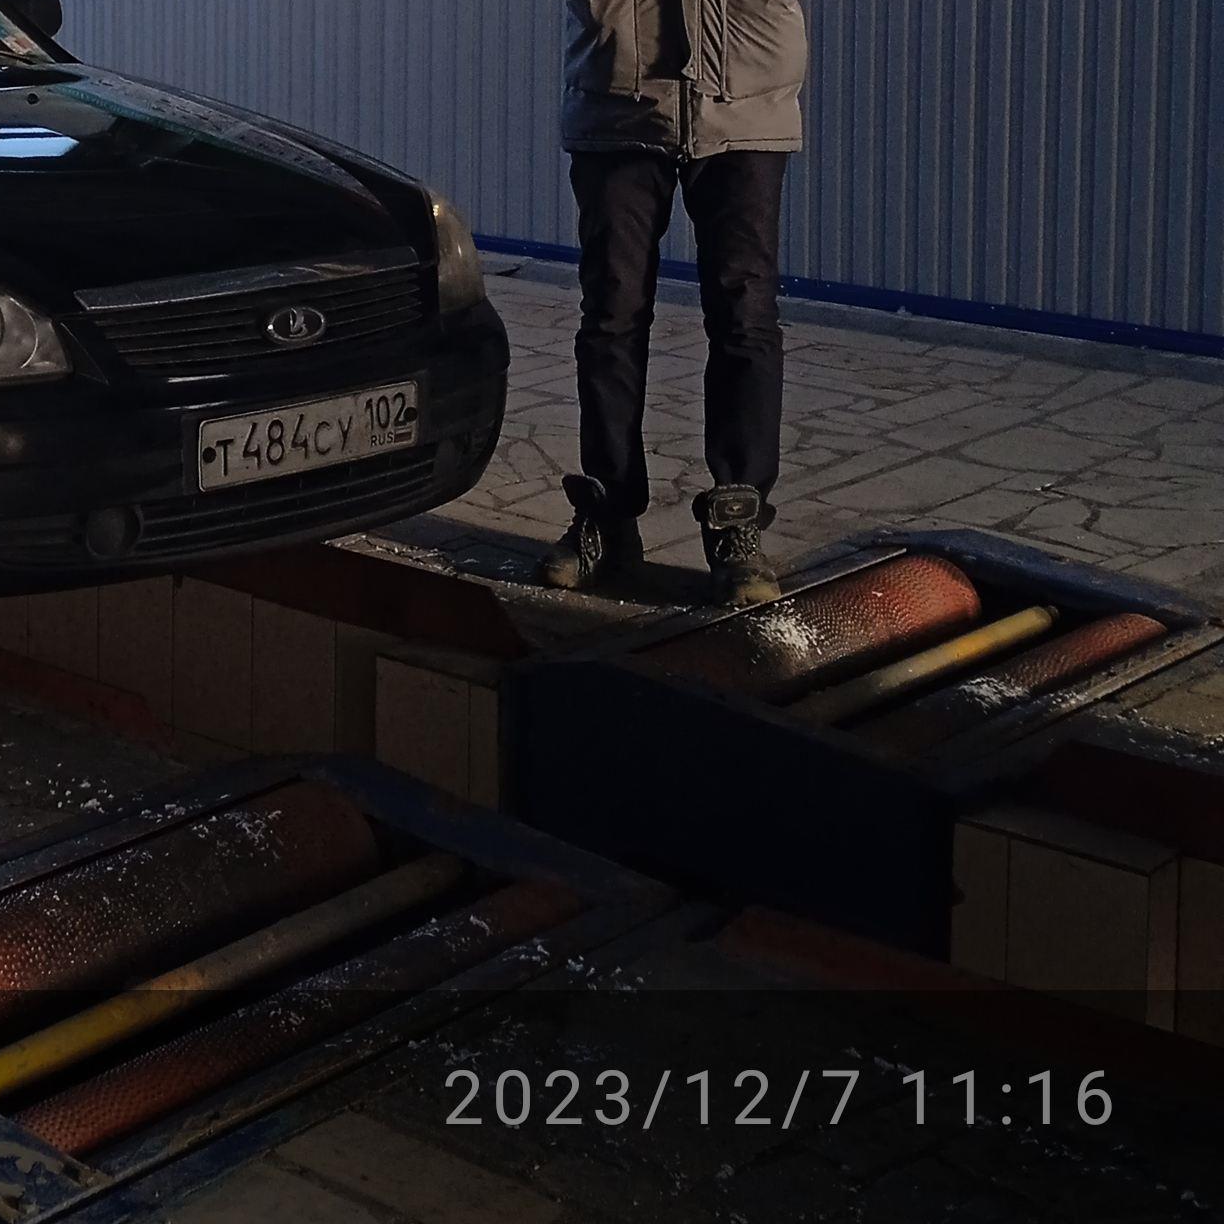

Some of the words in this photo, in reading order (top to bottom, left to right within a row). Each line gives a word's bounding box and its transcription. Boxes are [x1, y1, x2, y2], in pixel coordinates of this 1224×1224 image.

[215, 413, 352, 476] Т484СУ
[365, 392, 407, 431] 102
[370, 432, 394, 447] RUS
